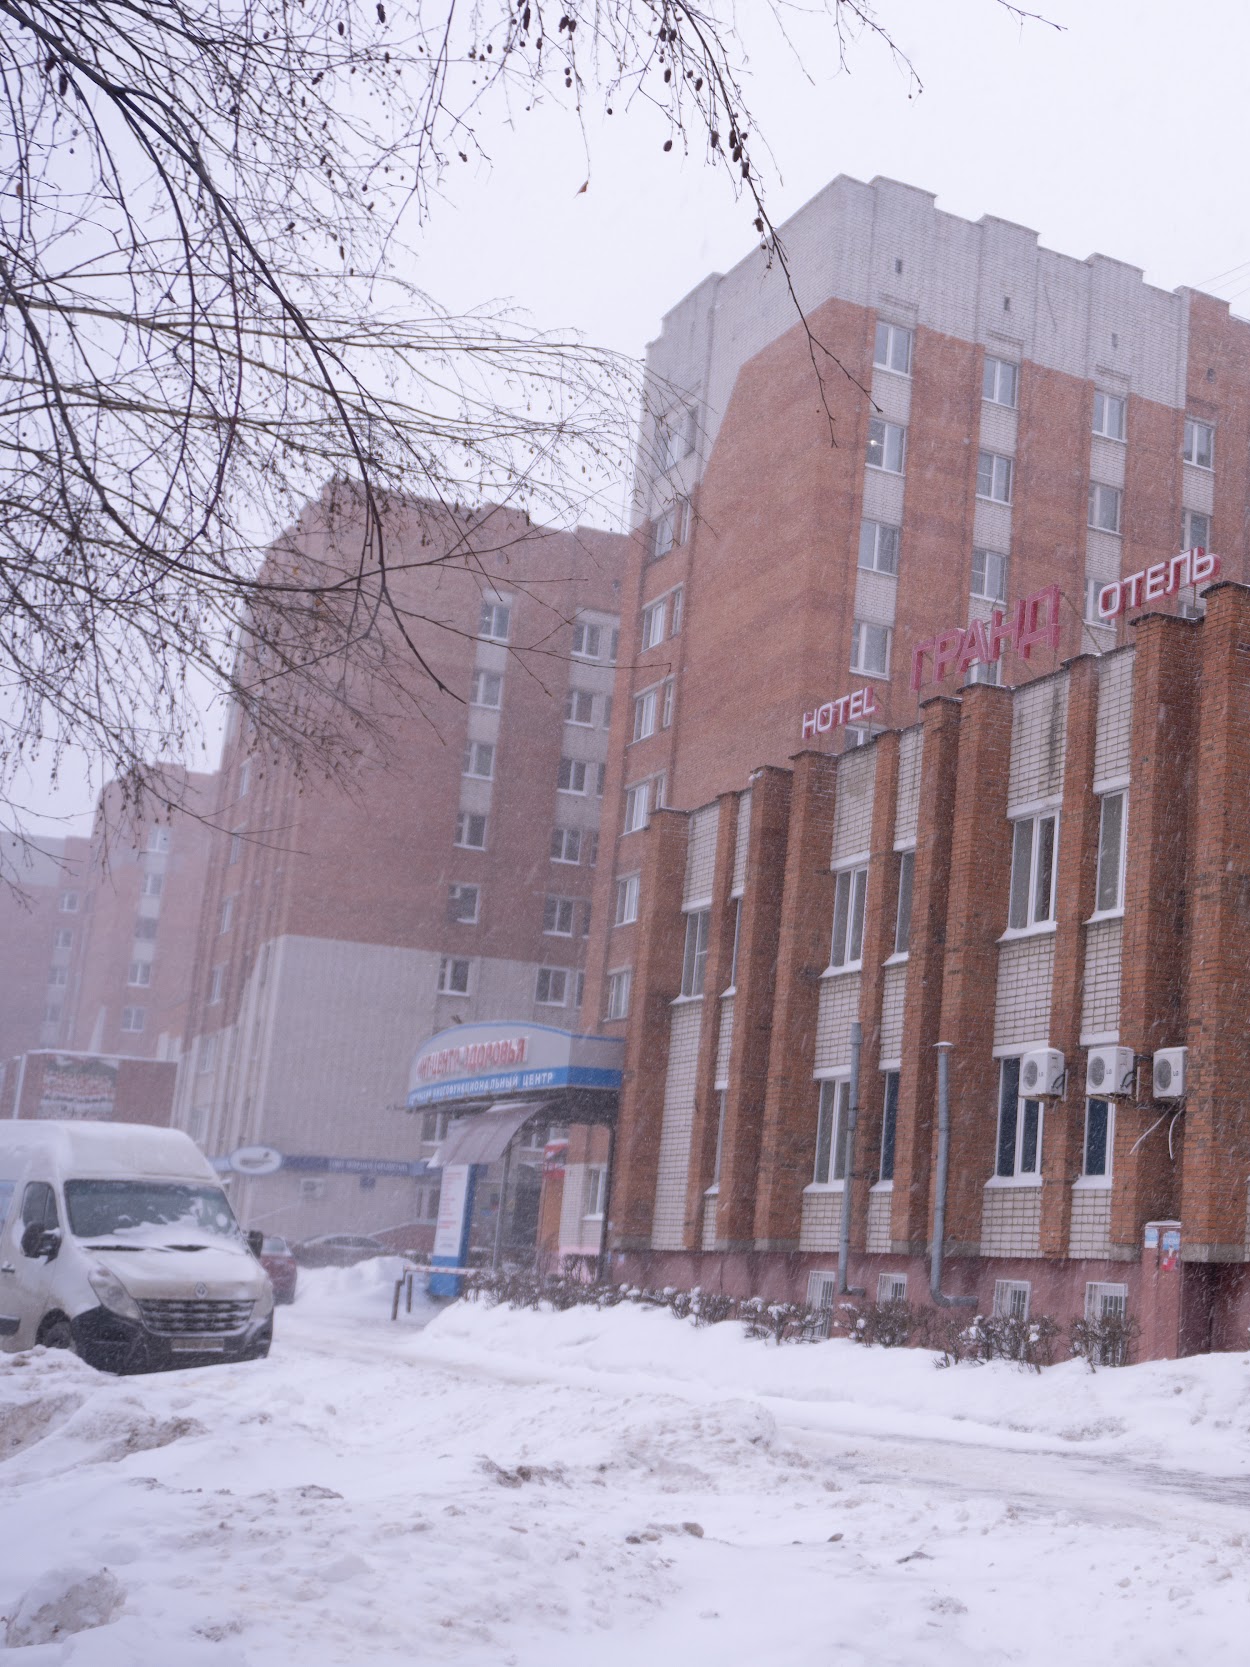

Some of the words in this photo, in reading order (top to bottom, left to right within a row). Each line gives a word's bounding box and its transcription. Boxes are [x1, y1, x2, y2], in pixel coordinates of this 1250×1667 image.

[801, 687, 880, 739] HOTEL
[910, 584, 1061, 691] ГРАНД
[1098, 546, 1221, 619] ОТЕЛЬ
[522, 1071, 553, 1087] ЦЕНТР
